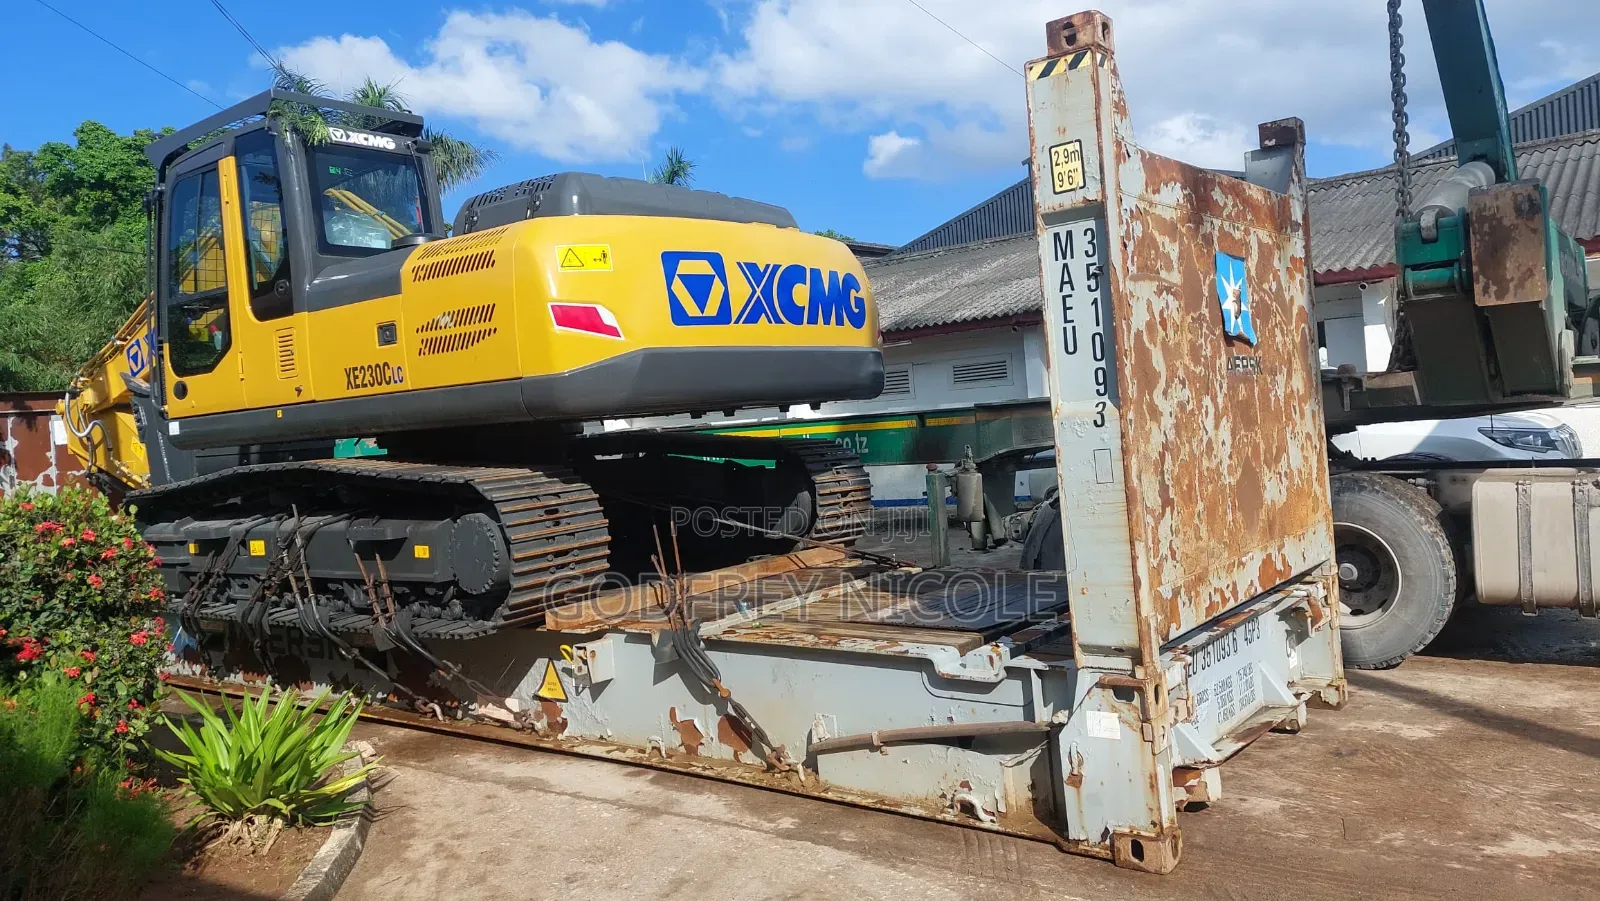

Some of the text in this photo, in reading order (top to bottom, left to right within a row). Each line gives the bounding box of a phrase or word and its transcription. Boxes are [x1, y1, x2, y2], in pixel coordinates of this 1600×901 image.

[346, 131, 396, 150] XCMG
[1053, 148, 1080, 168] 2,9m
[733, 261, 866, 329] XCMG
[1053, 229, 1078, 356] MAEU
[1083, 227, 1108, 428] 351093
